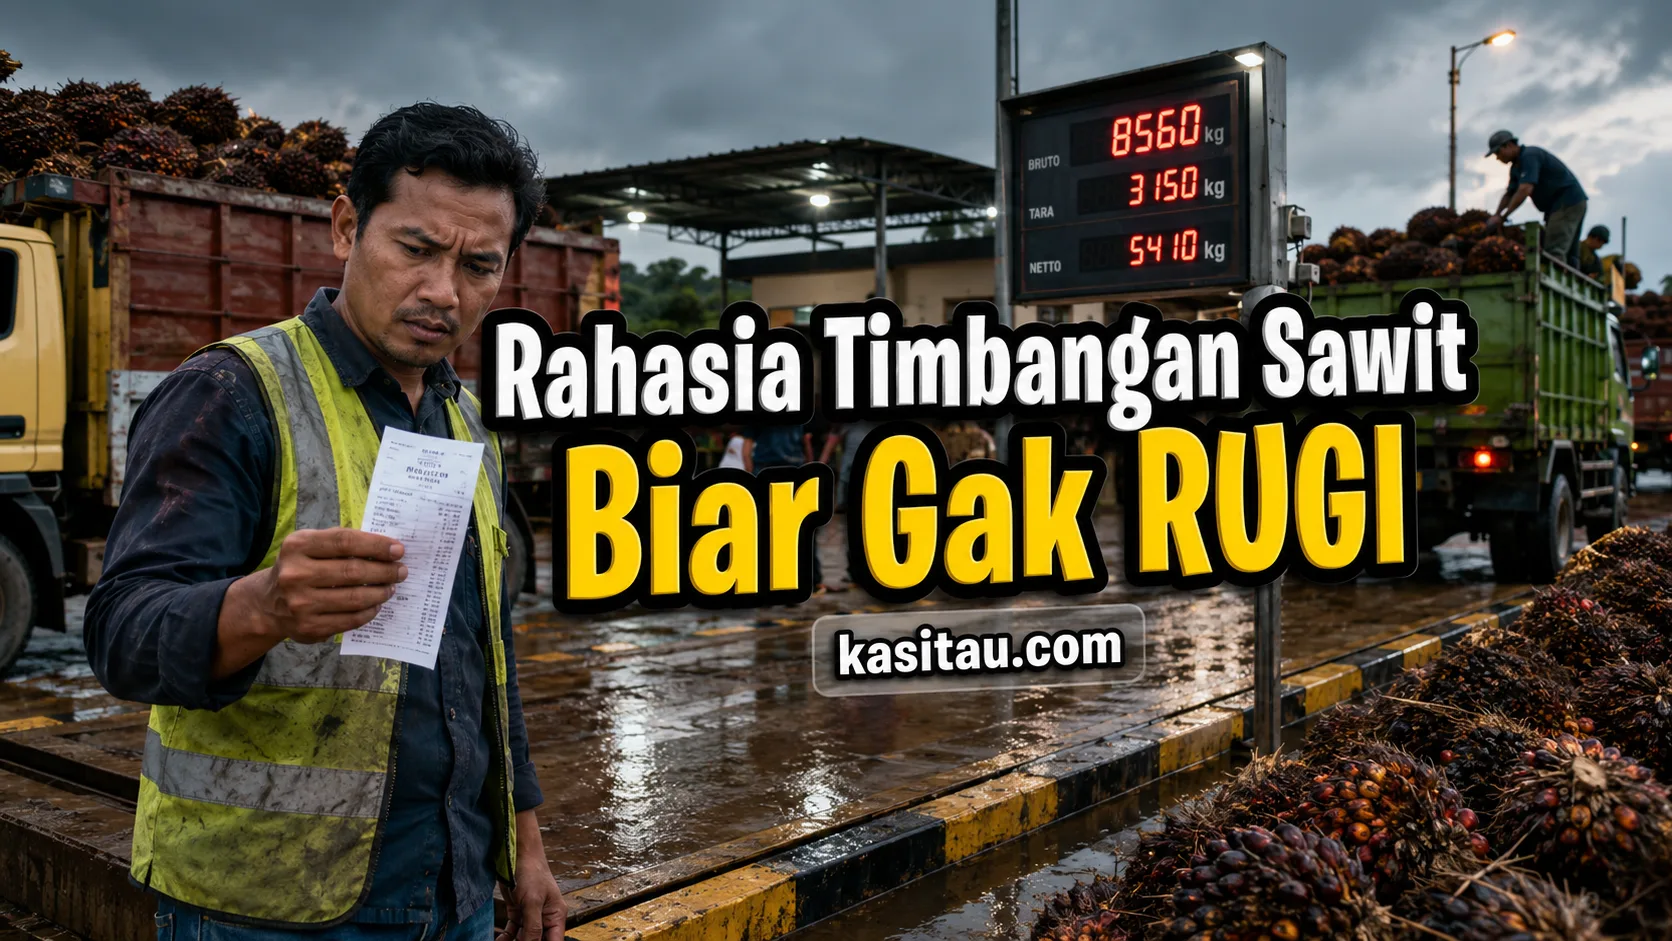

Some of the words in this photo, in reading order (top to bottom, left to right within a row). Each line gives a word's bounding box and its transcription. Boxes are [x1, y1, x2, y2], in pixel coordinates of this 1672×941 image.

[1028, 155, 1060, 171] BRUTO
[1111, 103, 1202, 158] 8560
[1204, 126, 1225, 145] kg
[1029, 205, 1054, 220] TARA
[1129, 165, 1198, 207] 3150
[1204, 178, 1225, 199] kg
[1029, 260, 1061, 274] NETTO
[1129, 228, 1198, 267] 5410
[1204, 241, 1225, 262] kg
